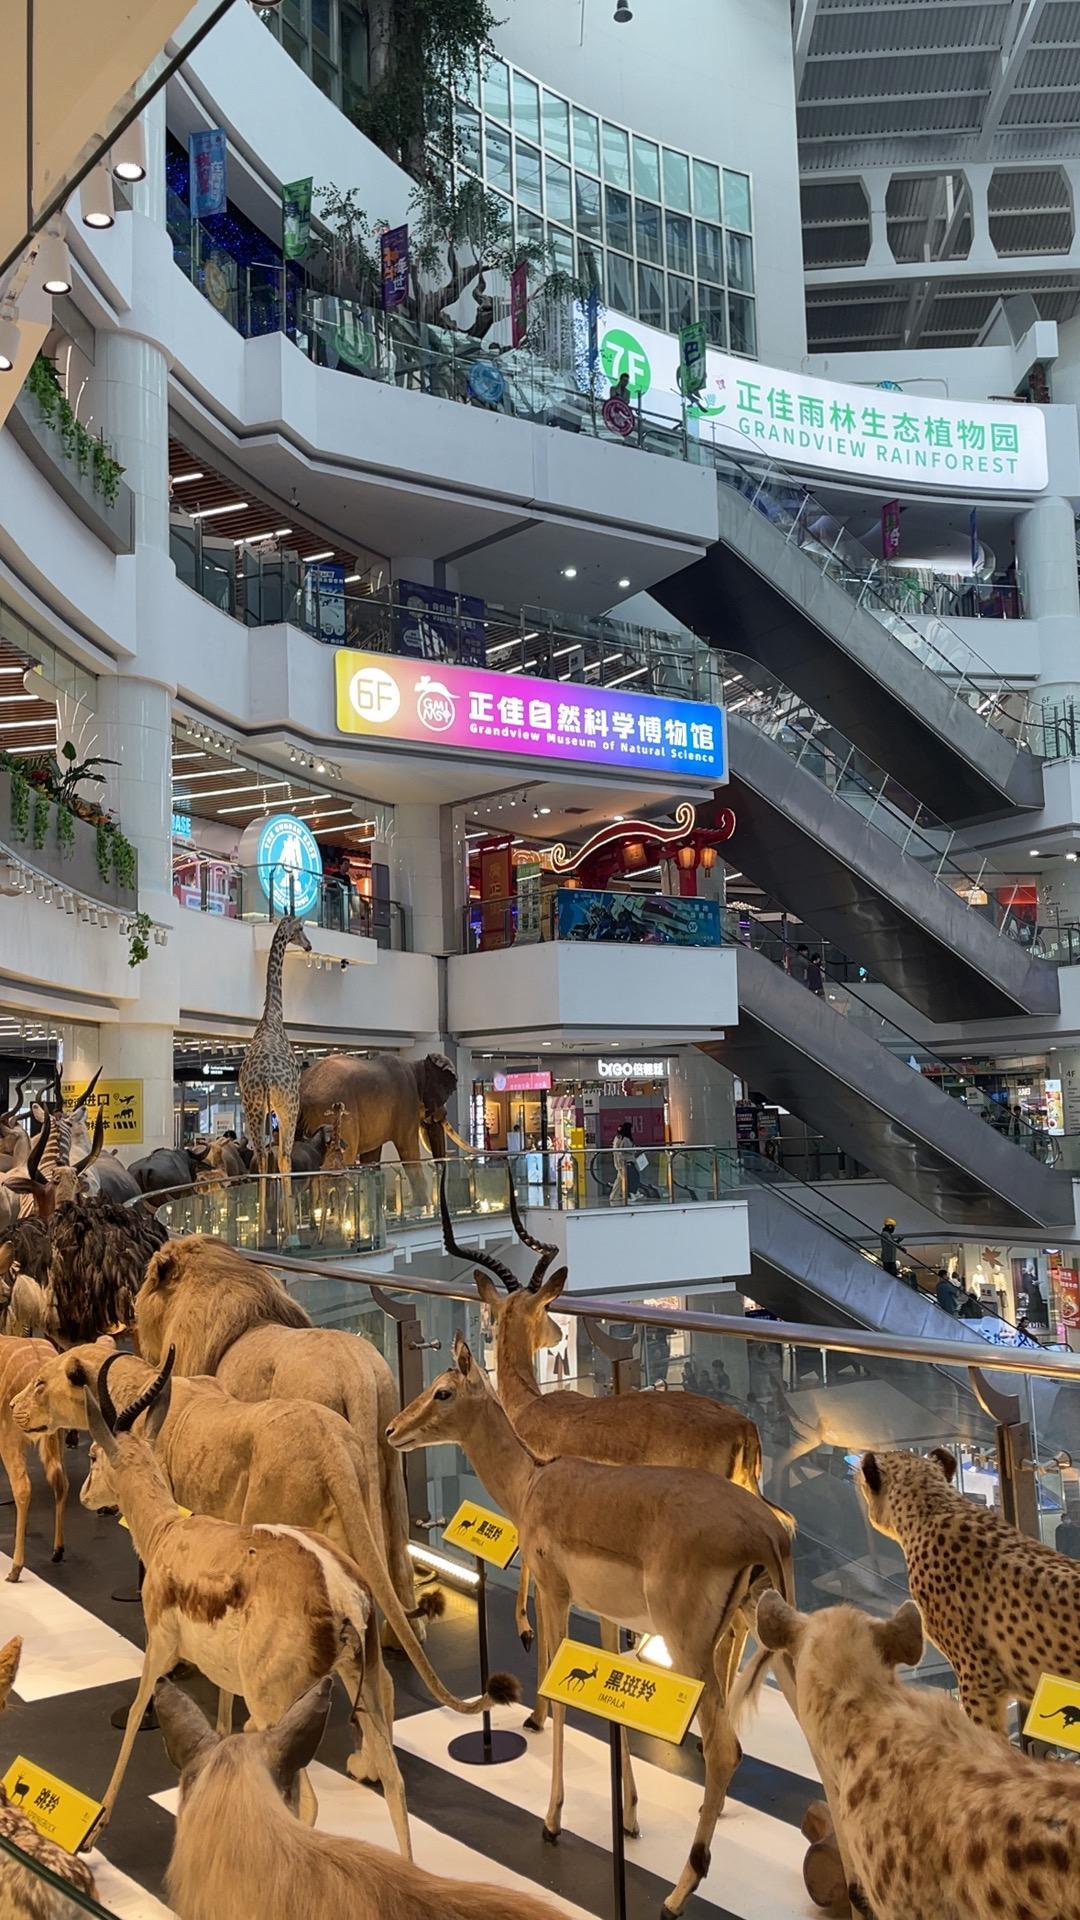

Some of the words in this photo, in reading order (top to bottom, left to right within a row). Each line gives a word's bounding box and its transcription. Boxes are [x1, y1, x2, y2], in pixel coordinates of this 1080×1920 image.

[606, 340, 645, 385] 7F
[735, 379, 1019, 453] 正佳雨林生态植物园
[738, 416, 866, 458] GRANDVIEW
[876, 444, 1018, 474] RAINFOREST
[356, 678, 392, 711] 6F
[468, 691, 714, 751] 正佳自然科学博物馆
[469, 723, 541, 742] Grandview
[546, 733, 597, 749] Museum
[602, 741, 616, 751] of
[620, 743, 666, 757] Natural
[671, 750, 714, 763] Science
[476, 1520, 504, 1542] 黑斑羚
[597, 1692, 625, 1709] IMPALA
[603, 1669, 657, 1702] 黑斑羚
[33, 1787, 61, 1814] 跳羚
